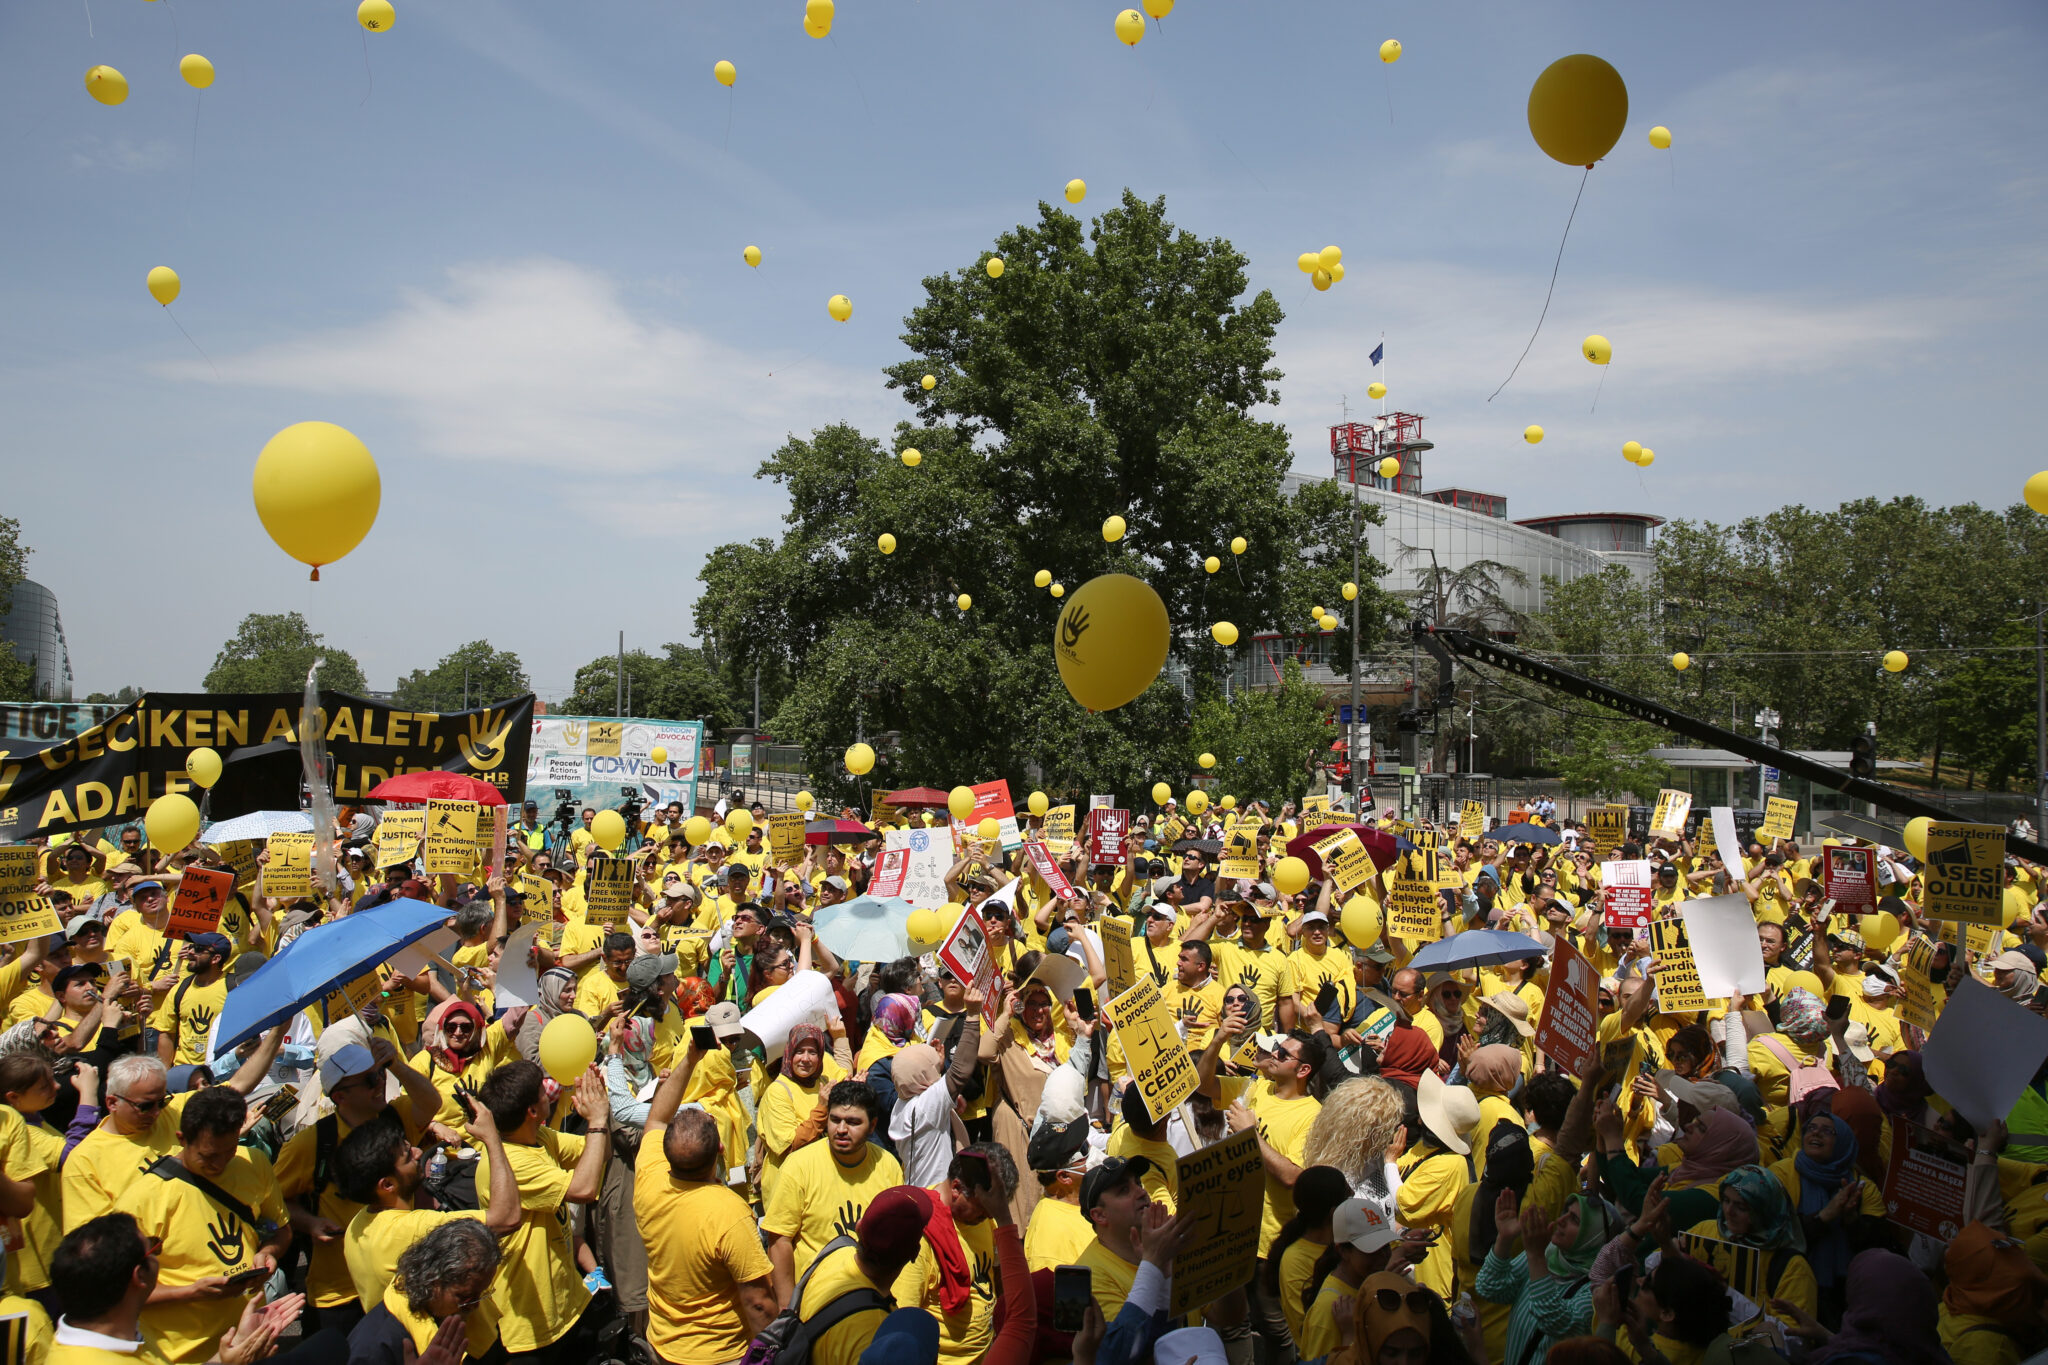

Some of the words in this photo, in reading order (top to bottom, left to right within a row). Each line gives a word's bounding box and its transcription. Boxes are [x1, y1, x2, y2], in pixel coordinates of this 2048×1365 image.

[656, 733, 695, 742] ADVOCACY
[550, 759, 583, 767] Peaceful
[550, 766, 578, 774] Actions
[550, 773, 582, 781] Platform
[641, 765, 667, 777] DDH
[429, 801, 476, 812] Protect
[1046, 812, 1071, 821] STOP
[1323, 812, 1355, 823] Defendons
[427, 836, 442, 844] The
[443, 837, 476, 845] Children
[1316, 831, 1352, 850] silence,
[1927, 827, 2005, 840] Sessizlerin
[428, 846, 437, 854] in
[440, 846, 473, 856] Turkey!
[1339, 847, 1363, 863] Conseil
[1340, 853, 1369, 873] l'Europe!
[184, 871, 211, 884] TIME
[1347, 869, 1363, 881] ECHR
[1948, 864, 2001, 884] SESİ
[524, 877, 541, 888] TIME
[1393, 882, 1430, 893] Justice
[178, 888, 199, 899] FOR
[1927, 881, 2001, 900] OLUN!
[1392, 892, 1433, 906] delayed
[171, 907, 219, 922] JUSTICE!
[1390, 903, 1400, 912] is
[1401, 904, 1436, 915] justice
[1945, 903, 1979, 913] ECHR
[10, 922, 39, 932] ECHR
[1393, 914, 1432, 926] denied!
[1103, 919, 1127, 936] Accélérez
[1400, 926, 1425, 934] ECHR
[1661, 972, 1700, 986] justic
[1114, 982, 1153, 1016] Accélérez
[1556, 987, 1574, 1004] STOP
[1678, 998, 1704, 1006] ECHR
[1114, 1018, 1125, 1031] le
[1126, 991, 1162, 1027] processus
[1558, 1000, 1590, 1031] VIOLATING
[1550, 1005, 1562, 1021] THE
[1563, 1016, 1586, 1040] RIGHTS
[1550, 1019, 1590, 1054] PRISONERS!
[1138, 1068, 1152, 1083] de
[1152, 1045, 1184, 1075] justice,
[1144, 1054, 1190, 1098] CEDH!
[1165, 1082, 1188, 1104] ECHR
[1179, 1151, 1223, 1182] Don't
[1225, 1136, 1258, 1161] turn
[1902, 1159, 1937, 1178] MUSTAFA
[1185, 1172, 1223, 1201] your
[1227, 1156, 1264, 1186] eyes
[1361, 1208, 1382, 1226] LA
[1175, 1237, 1225, 1265] European
[1228, 1224, 1256, 1243] Court
[223, 1262, 248, 1277] ECHR
[1174, 1267, 1185, 1280] of
[1187, 1251, 1225, 1274] Human
[1196, 1271, 1234, 1295] ECHR
